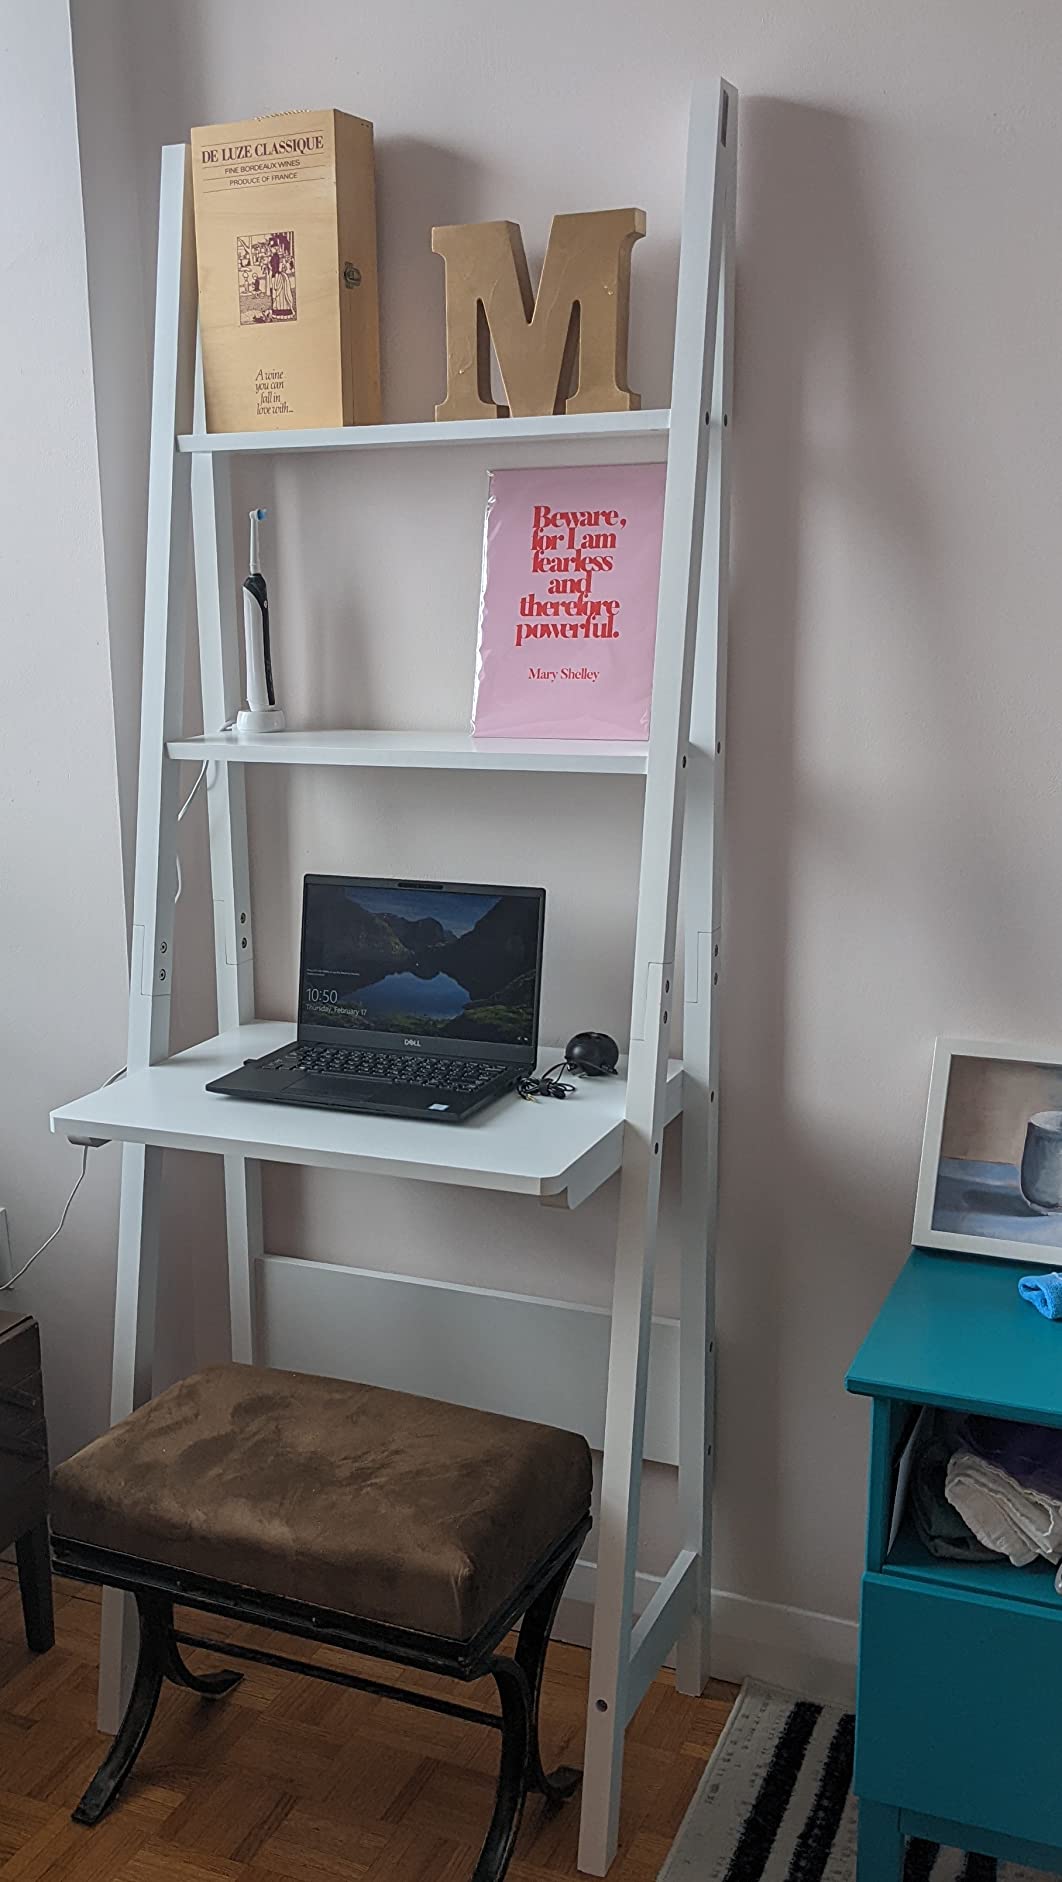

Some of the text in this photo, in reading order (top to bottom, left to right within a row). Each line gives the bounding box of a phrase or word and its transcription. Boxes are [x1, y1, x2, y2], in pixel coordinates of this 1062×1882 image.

[202, 136, 324, 164] DE LUZE CLASSIQUE
[224, 159, 301, 175] FINE BORDEAUX WINES
[229, 172, 298, 186] PRODUCE OF FRANCE
[255, 369, 284, 381] A wine
[255, 381, 284, 394] you can
[260, 391, 281, 405] fall in
[256, 402, 272, 415] love
[532, 505, 627, 529] Beware,
[530, 527, 616, 551] for I am
[532, 549, 613, 573] fearless
[547, 571, 592, 595] and
[519, 593, 620, 617] therefore
[515, 615, 619, 646] powerful.
[528, 668, 600, 683] Mary Shelley
[305, 988, 338, 1005] 10:50
[305, 1003, 368, 1017] Thursday, February 17
[404, 1038, 422, 1047] DELL
